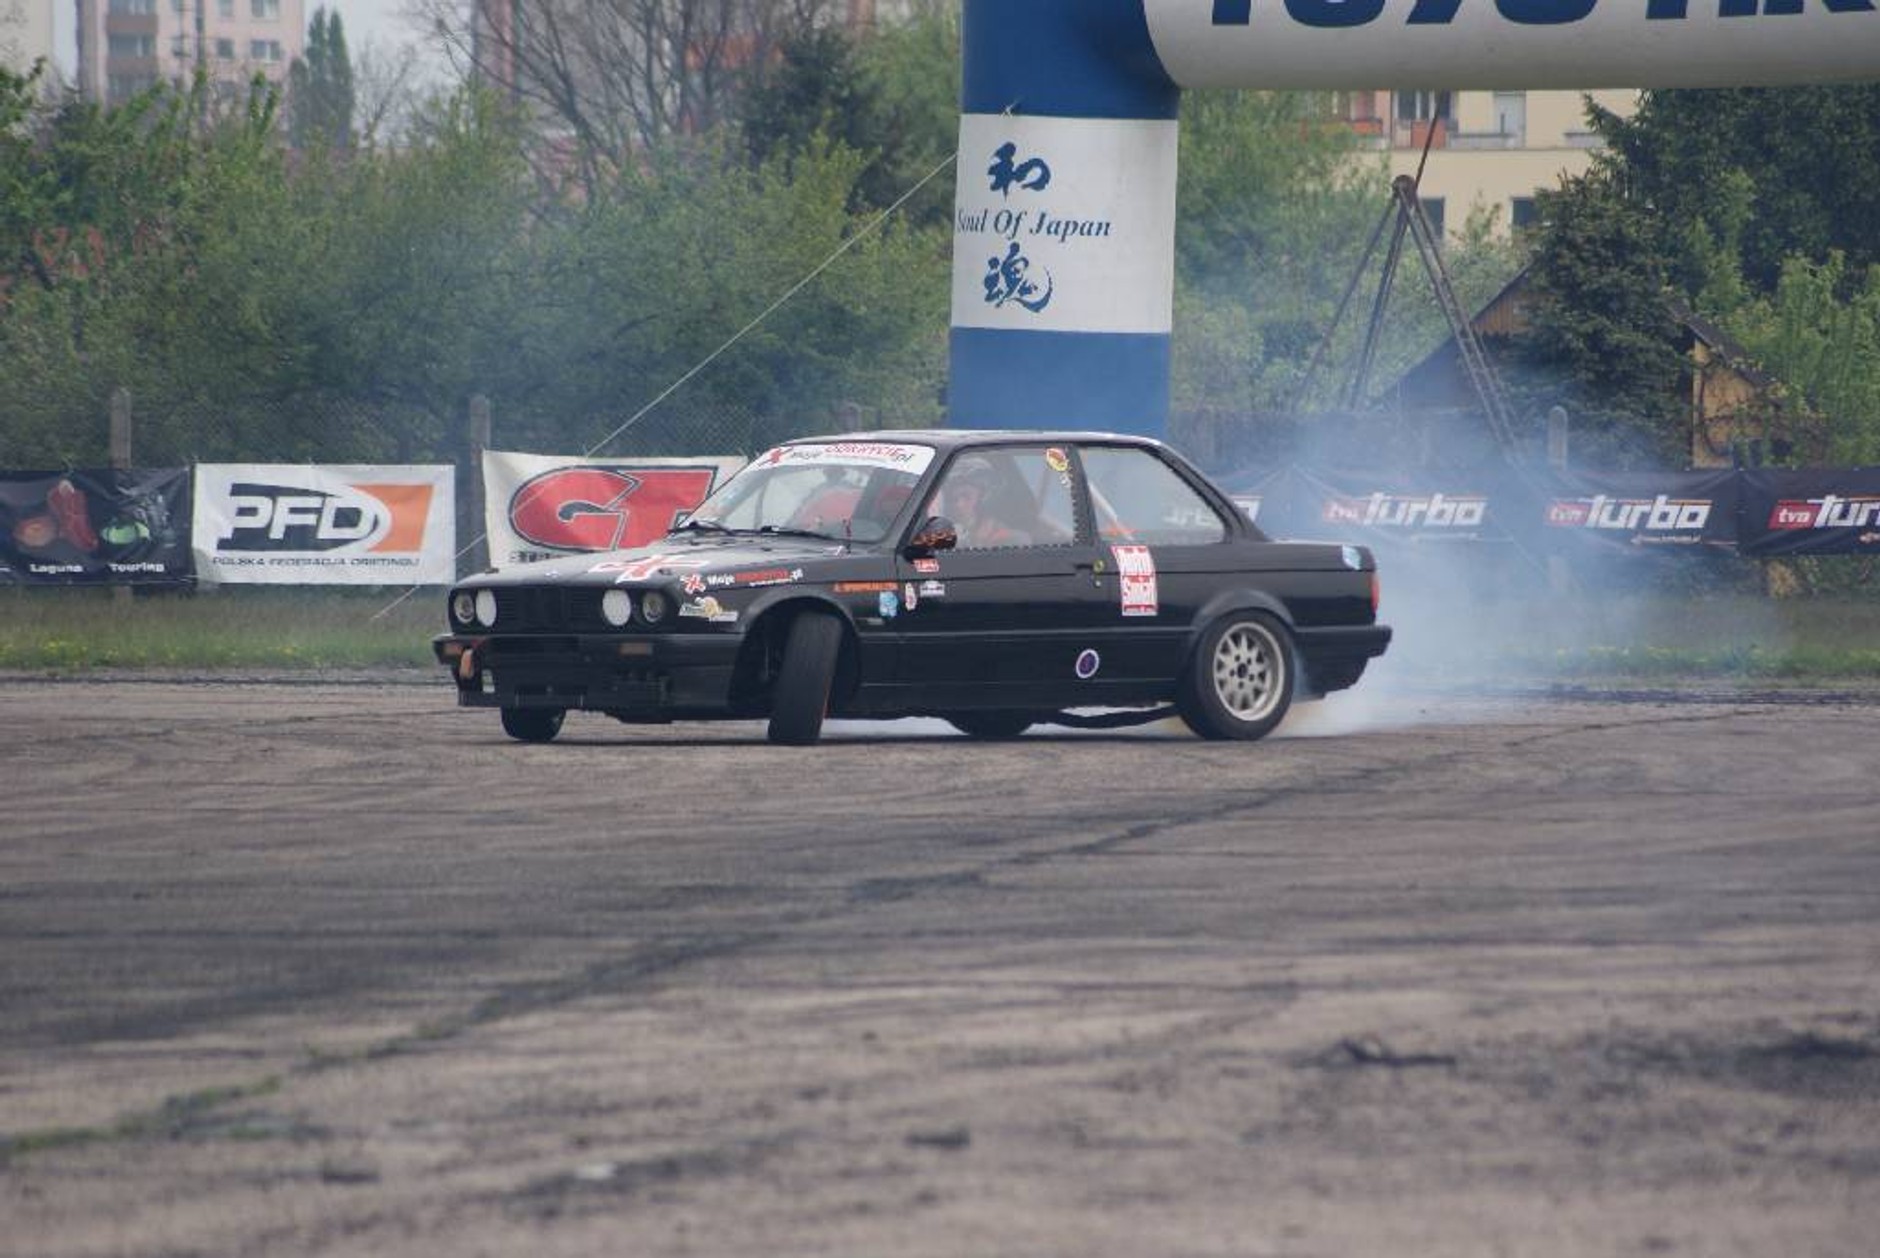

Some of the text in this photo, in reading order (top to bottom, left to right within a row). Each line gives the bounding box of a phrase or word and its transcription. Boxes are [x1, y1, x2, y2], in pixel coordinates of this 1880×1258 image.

[987, 141, 1051, 201] 和
[956, 208, 1111, 244] Soul Of Japan
[220, 491, 381, 543] PFD
[1362, 492, 1487, 526] turbo
[1580, 495, 1713, 529] turbo
[1778, 508, 1811, 523] tvn
[30, 562, 165, 574] Laguna Touring
[212, 556, 265, 566] POLSKA
